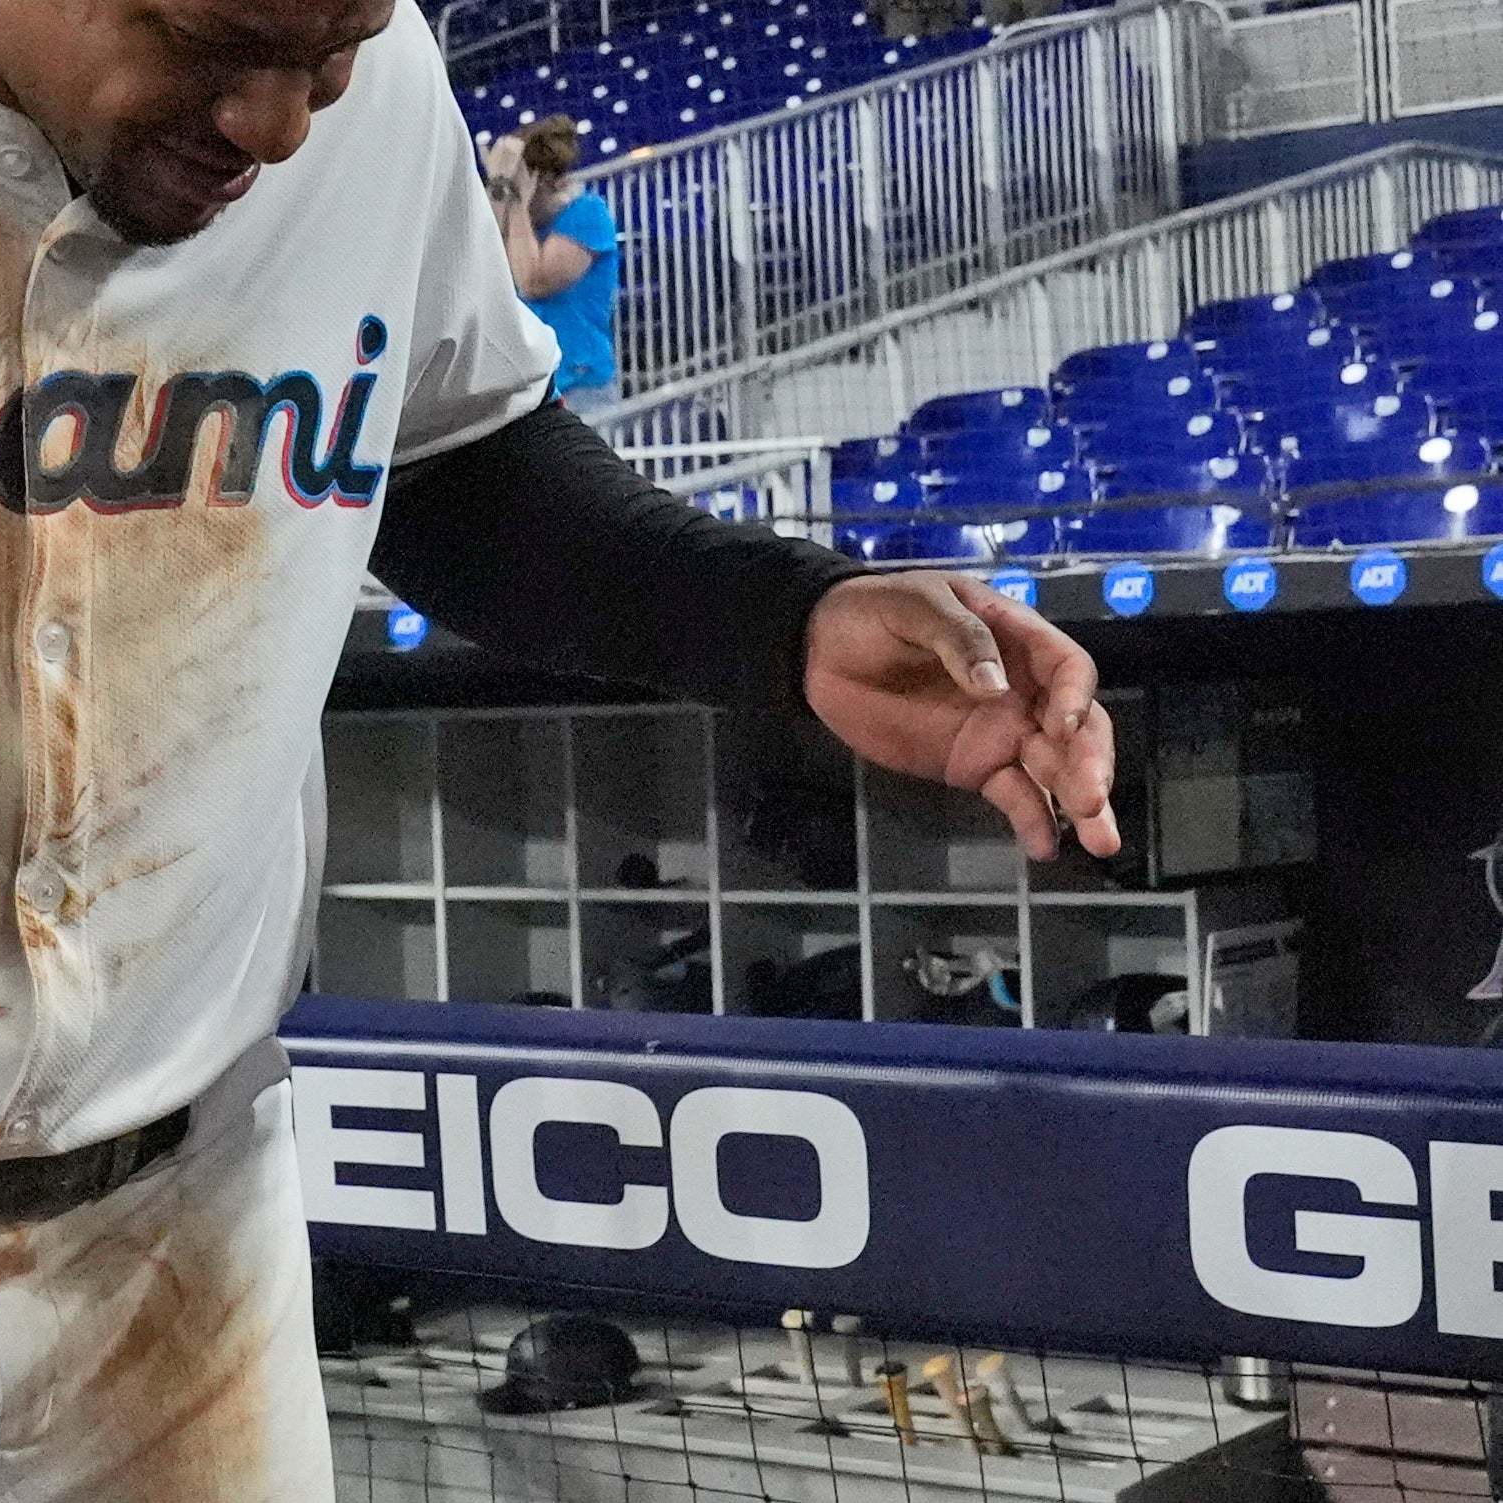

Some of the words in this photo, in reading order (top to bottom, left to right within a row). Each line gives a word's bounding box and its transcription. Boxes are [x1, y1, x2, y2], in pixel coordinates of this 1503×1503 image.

[1110, 576, 1147, 599] ADT
[1230, 571, 1268, 594] ADT
[1358, 565, 1398, 588] ADT
